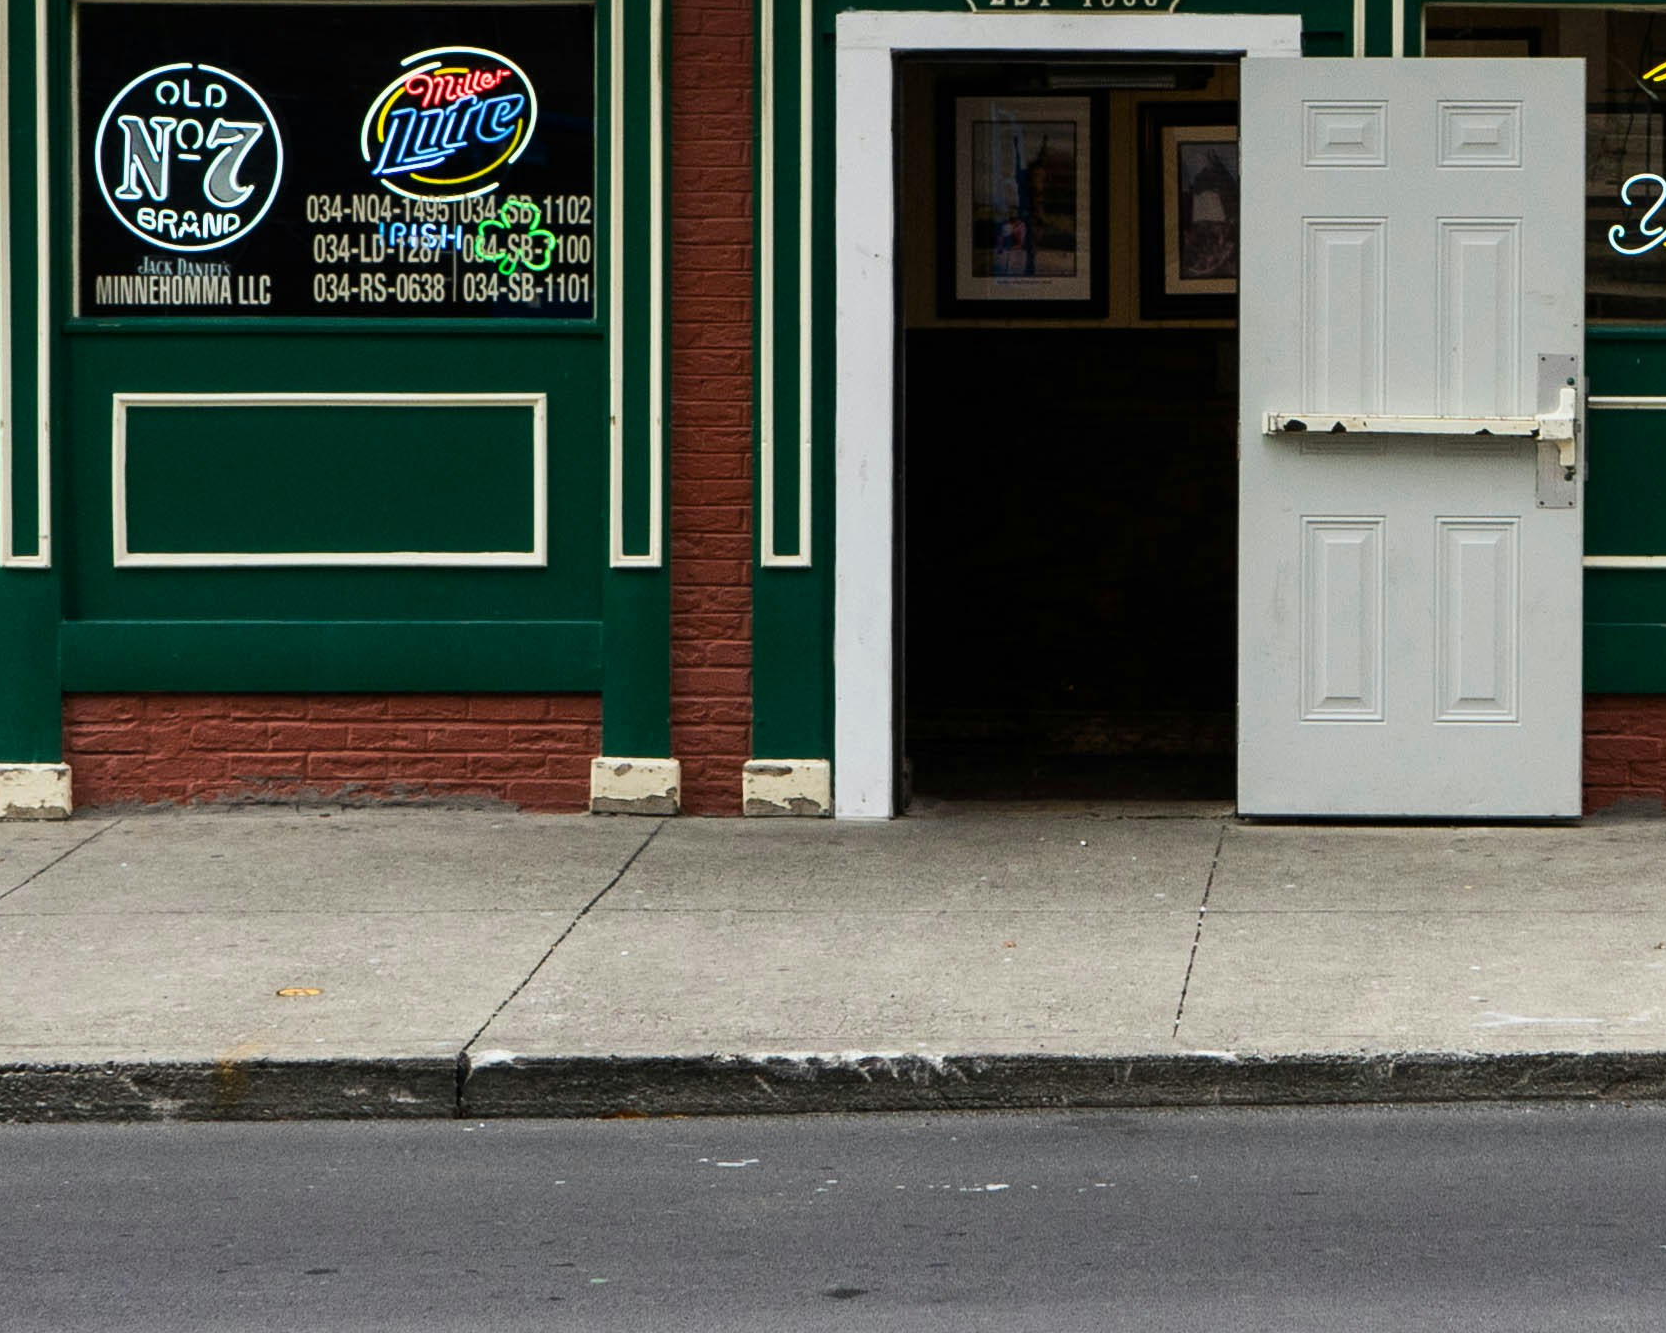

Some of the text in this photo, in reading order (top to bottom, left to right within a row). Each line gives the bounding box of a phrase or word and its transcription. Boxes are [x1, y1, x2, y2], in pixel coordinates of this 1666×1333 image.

[155, 79, 227, 108] OLD
[405, 69, 511, 108] Miller
[372, 94, 525, 176] Lite
[137, 207, 240, 239] BRAND
[378, 222, 463, 250] IRISH
[95, 274, 272, 306] MINNEHOMMA LLC
[313, 273, 590, 303] 034-RS-0638 034-SB-1101
